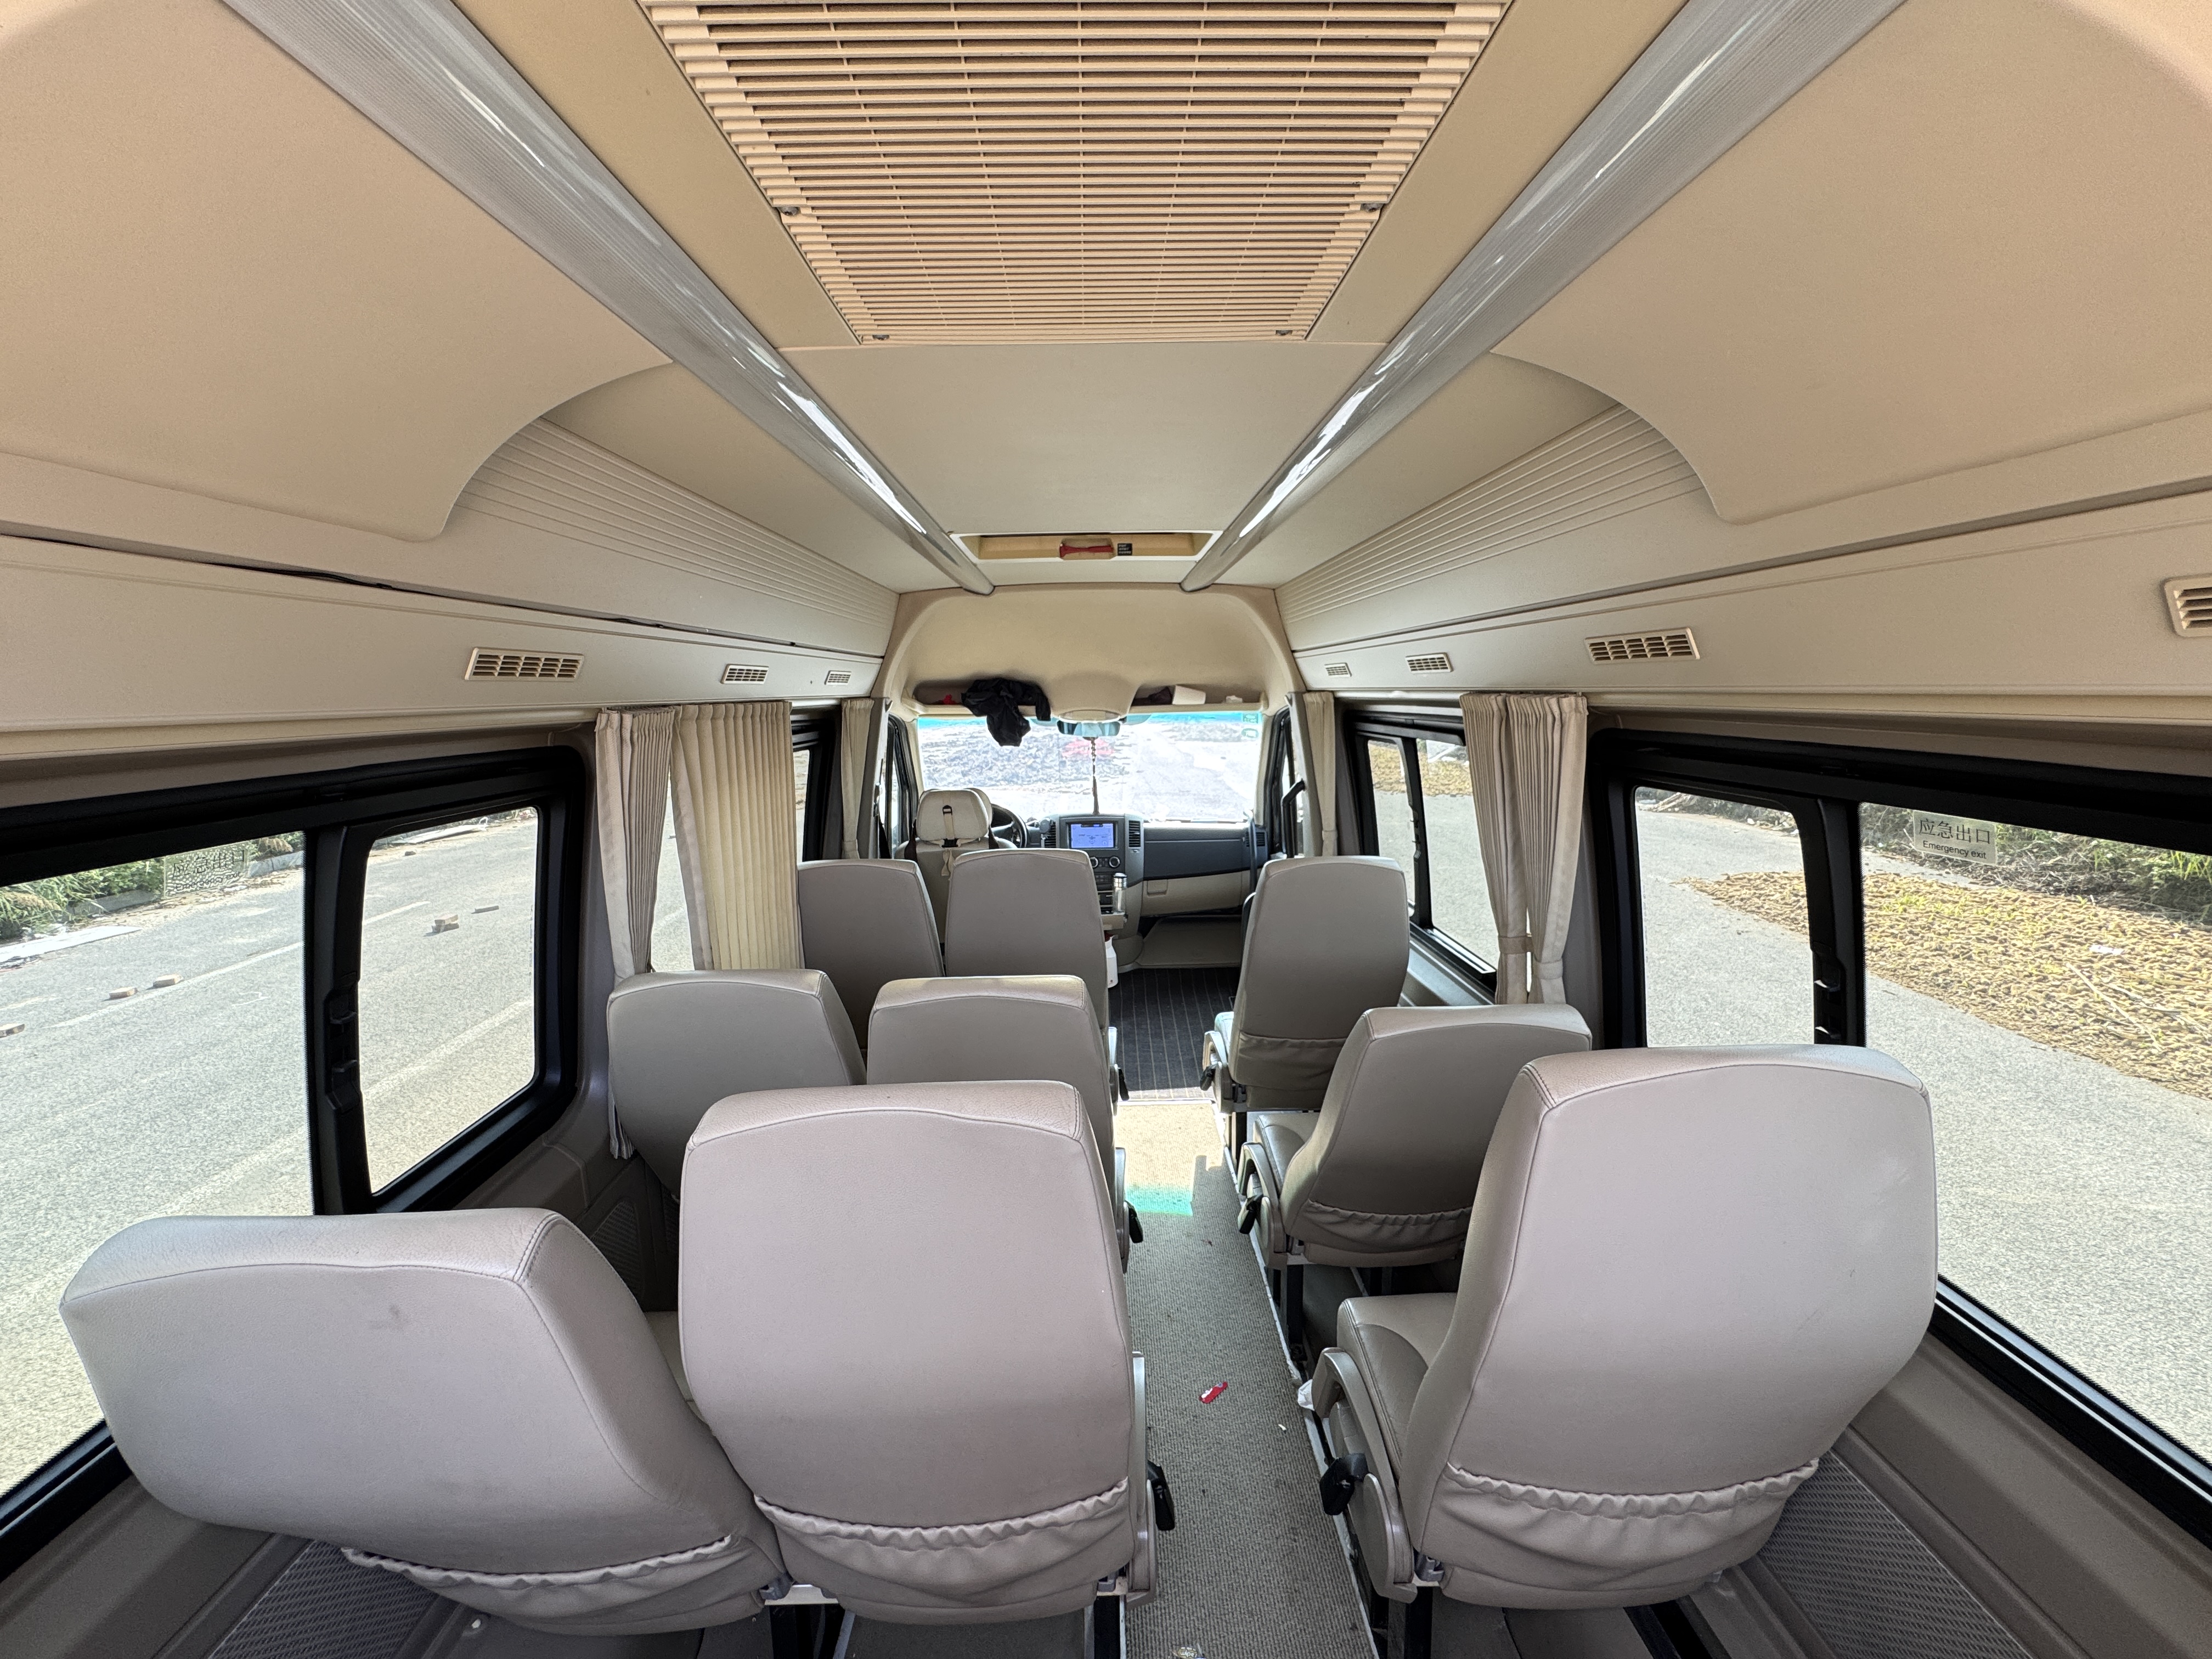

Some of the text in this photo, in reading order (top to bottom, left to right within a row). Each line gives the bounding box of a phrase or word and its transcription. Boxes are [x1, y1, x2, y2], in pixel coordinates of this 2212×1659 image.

[1919, 819, 1990, 844] 应急出口
[1923, 840, 1968, 857] Emergency
[173, 850, 244, 878] 应急出口
